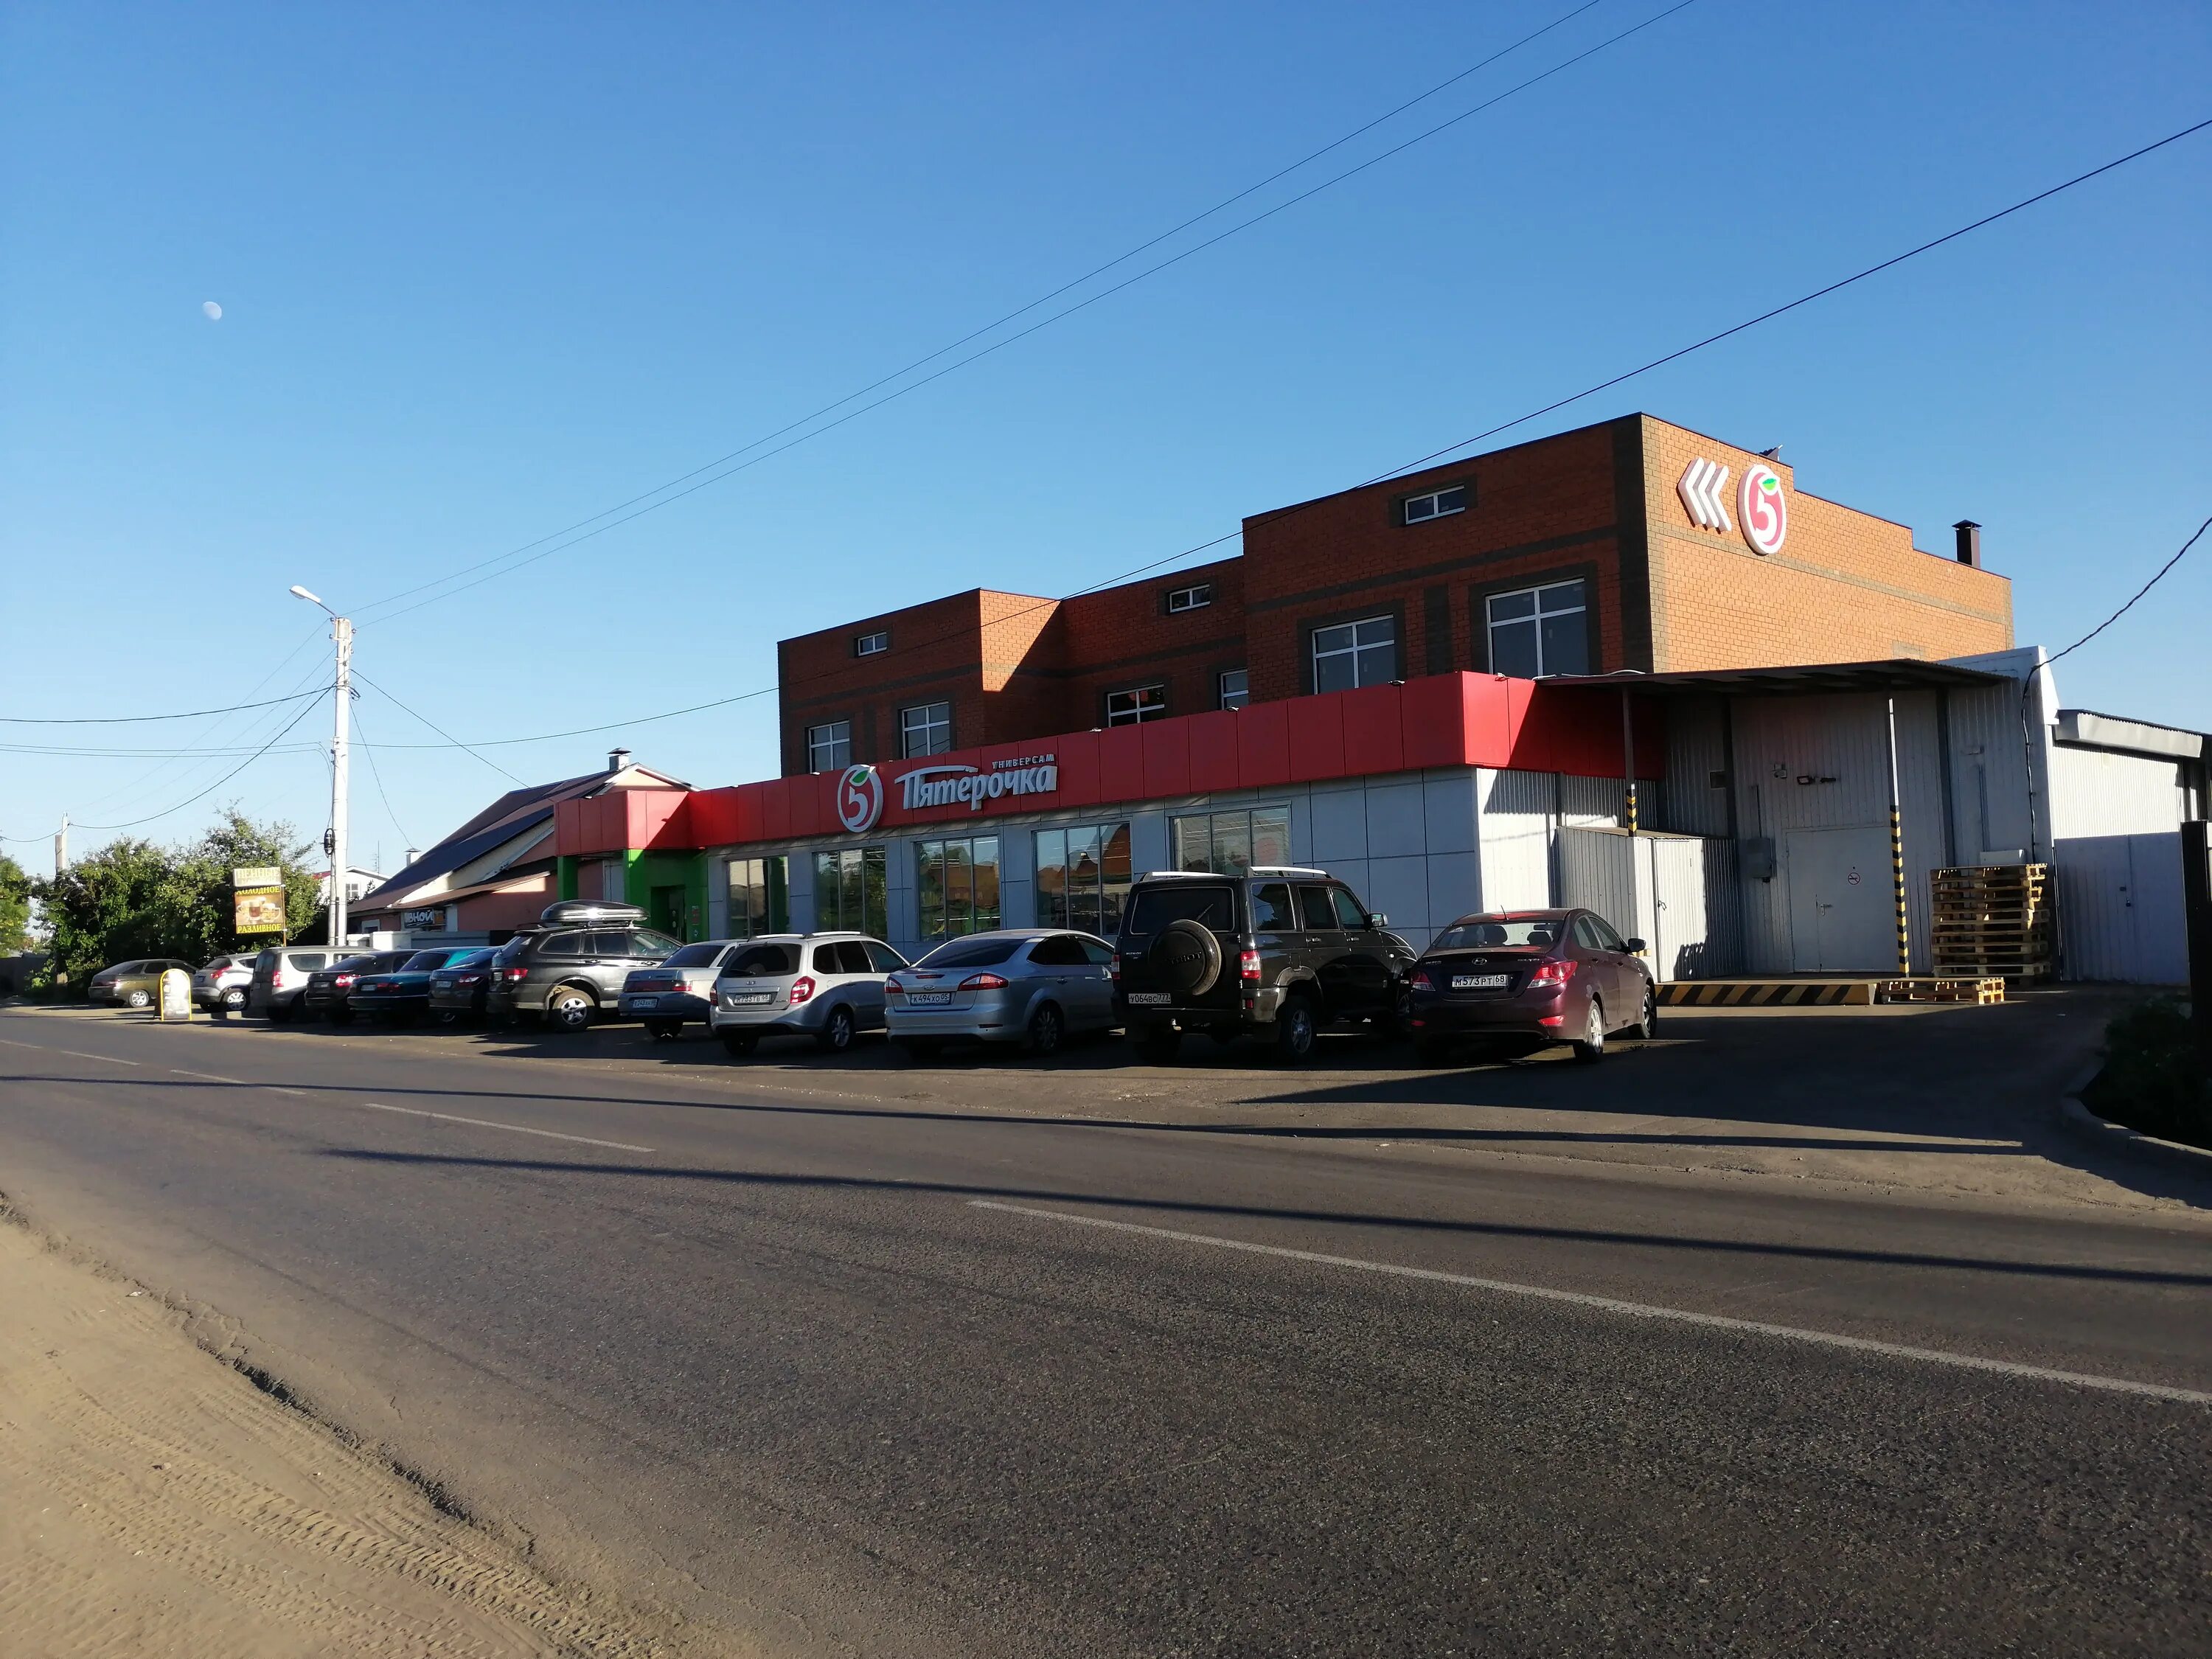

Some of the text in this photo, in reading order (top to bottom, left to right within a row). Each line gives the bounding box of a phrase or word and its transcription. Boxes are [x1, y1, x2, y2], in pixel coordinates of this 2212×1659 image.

[992, 753, 1055, 769] УНИВЕРСАМ
[894, 764, 1058, 811] Пятерочка
[237, 923, 282, 934] РАЗЛИВНОЕ
[1455, 976, 1492, 986] М573РТ
